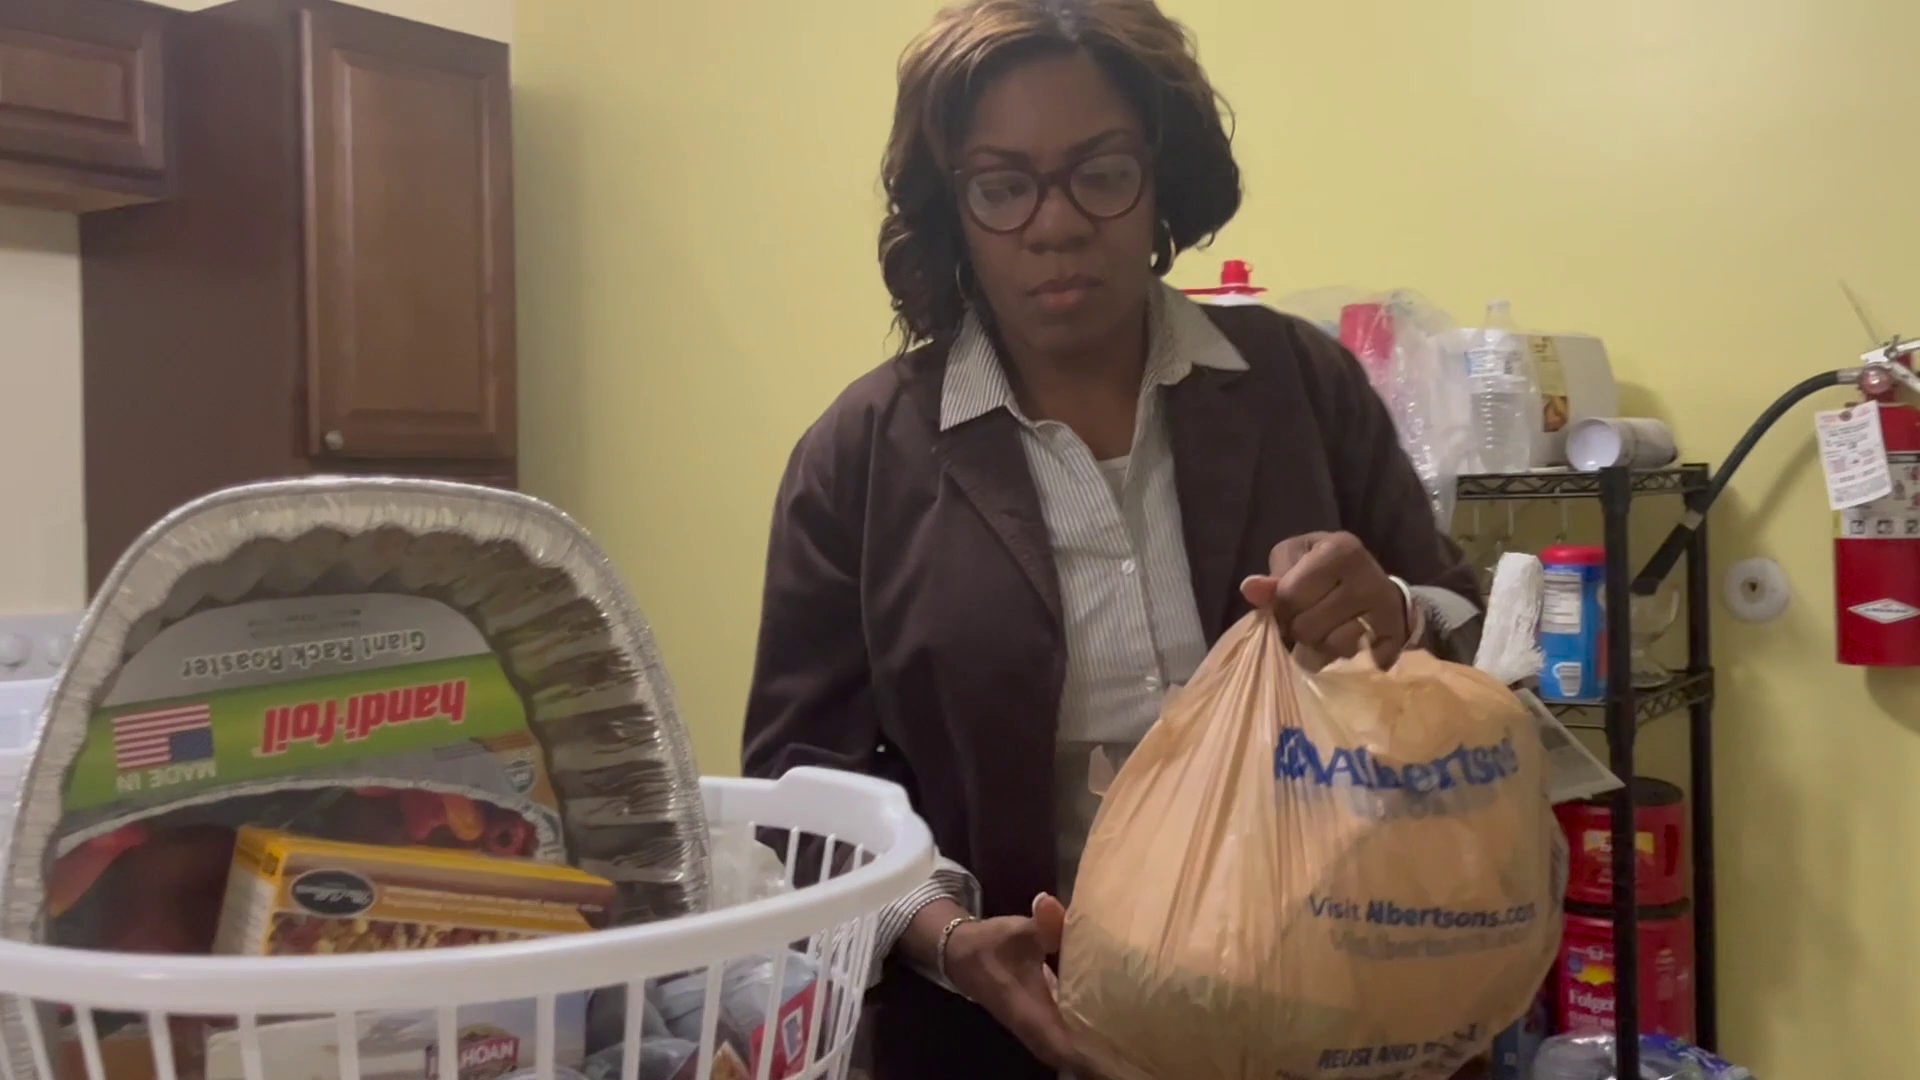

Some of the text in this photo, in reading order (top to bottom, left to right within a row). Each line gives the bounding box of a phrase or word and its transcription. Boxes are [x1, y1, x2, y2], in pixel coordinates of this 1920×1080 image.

[181, 629, 427, 679] Giant Rack Roaster
[115, 762, 217, 793] MADE IN
[1320, 735, 1520, 791] Alberts
[1309, 894, 1361, 922] Visit
